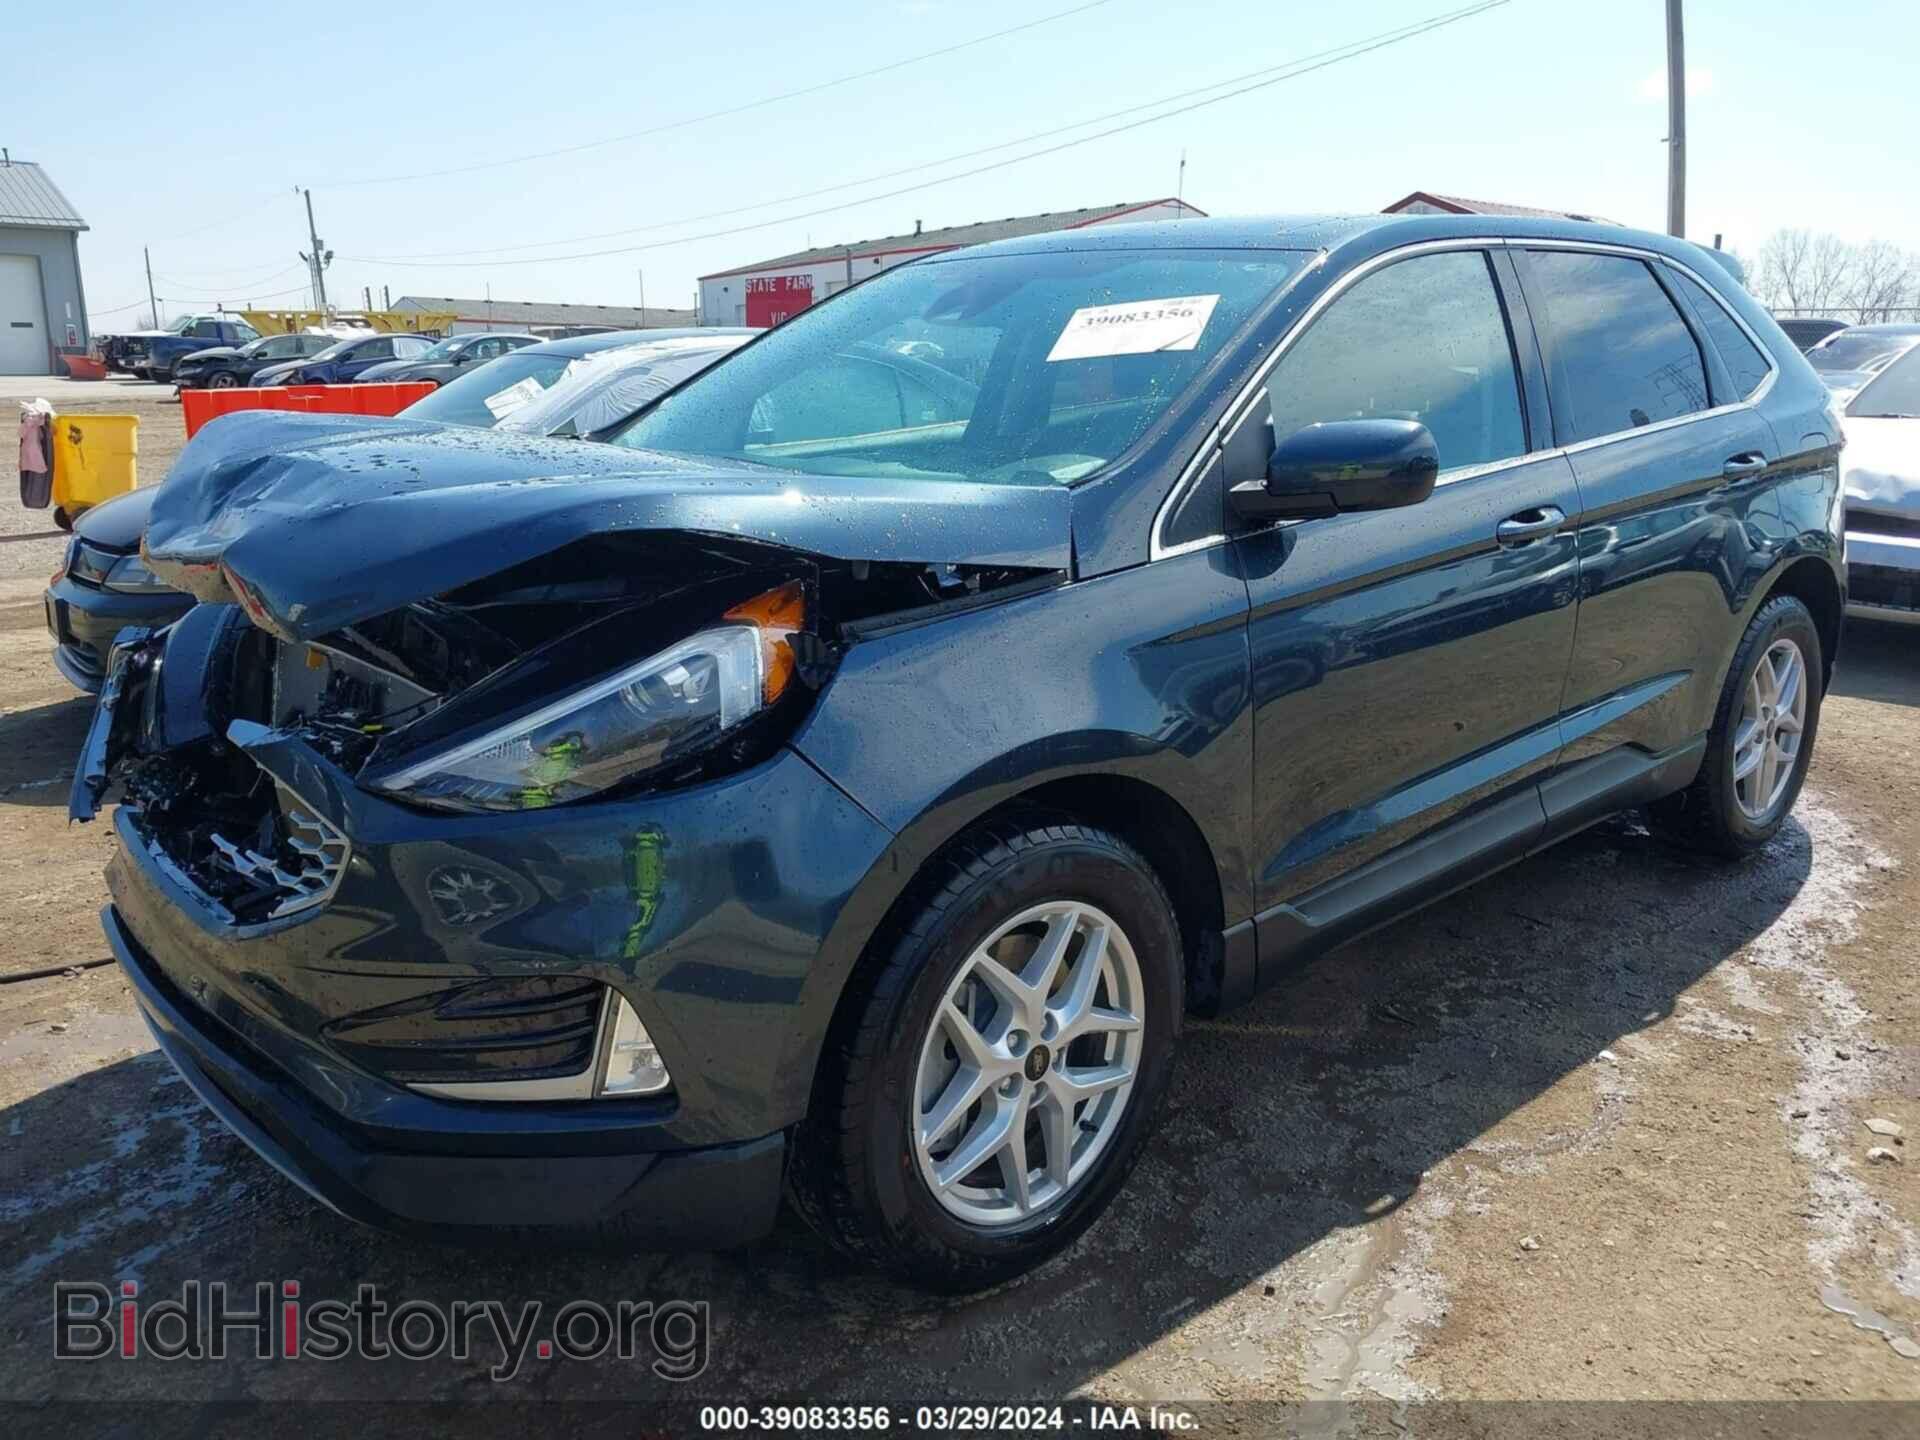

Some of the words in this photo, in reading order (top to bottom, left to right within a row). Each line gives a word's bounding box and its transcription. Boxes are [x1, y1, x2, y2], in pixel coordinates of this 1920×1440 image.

[745, 278, 776, 294] STATE
[785, 275, 815, 291] FARM
[1081, 307, 1193, 328] 39083356
